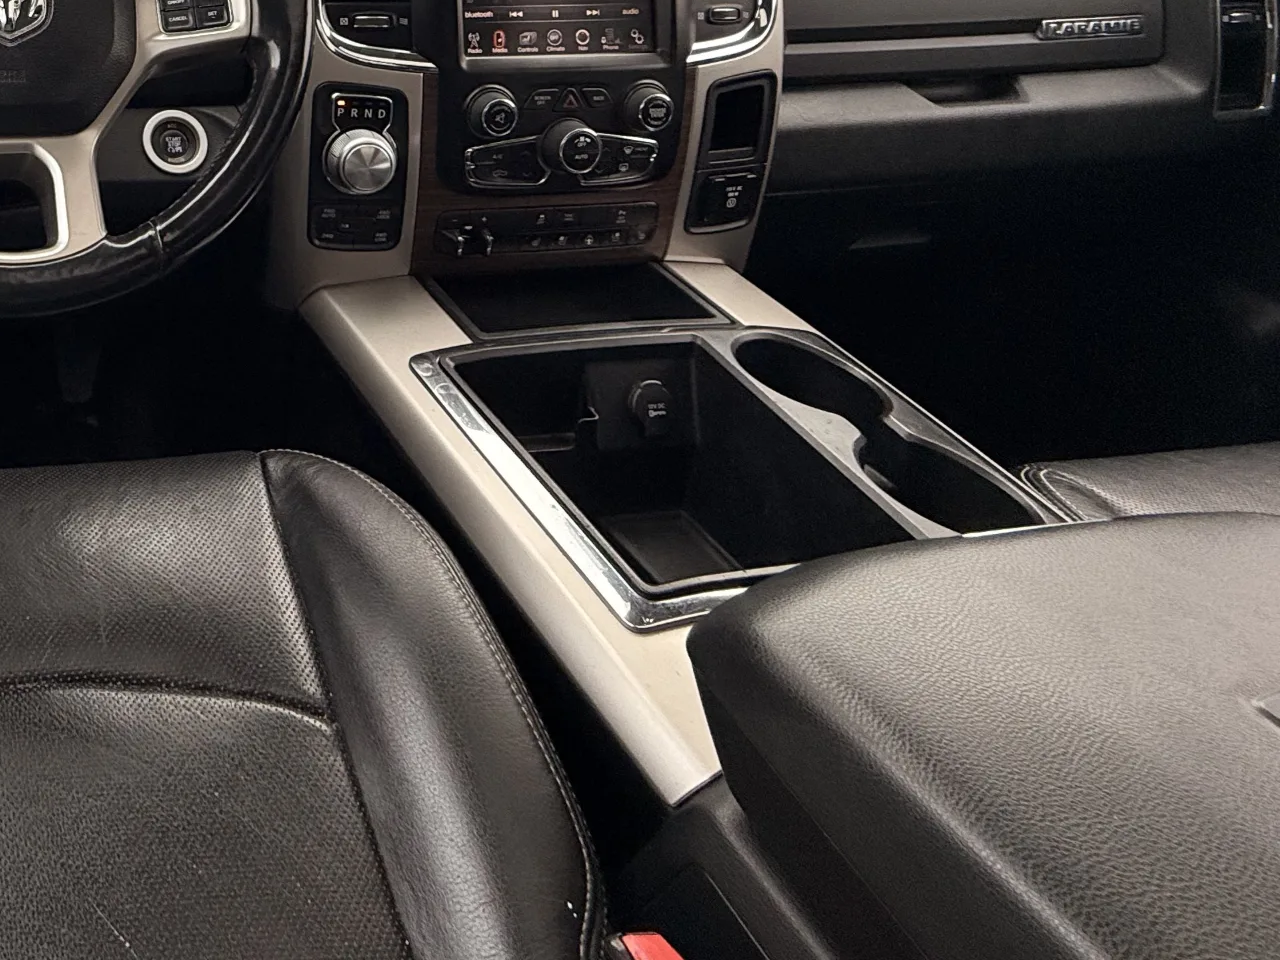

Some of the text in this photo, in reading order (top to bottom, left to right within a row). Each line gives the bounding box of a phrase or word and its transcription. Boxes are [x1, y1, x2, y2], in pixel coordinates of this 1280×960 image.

[1048, 19, 1142, 36] LARAMIE
[337, 107, 386, 119] P R N D
